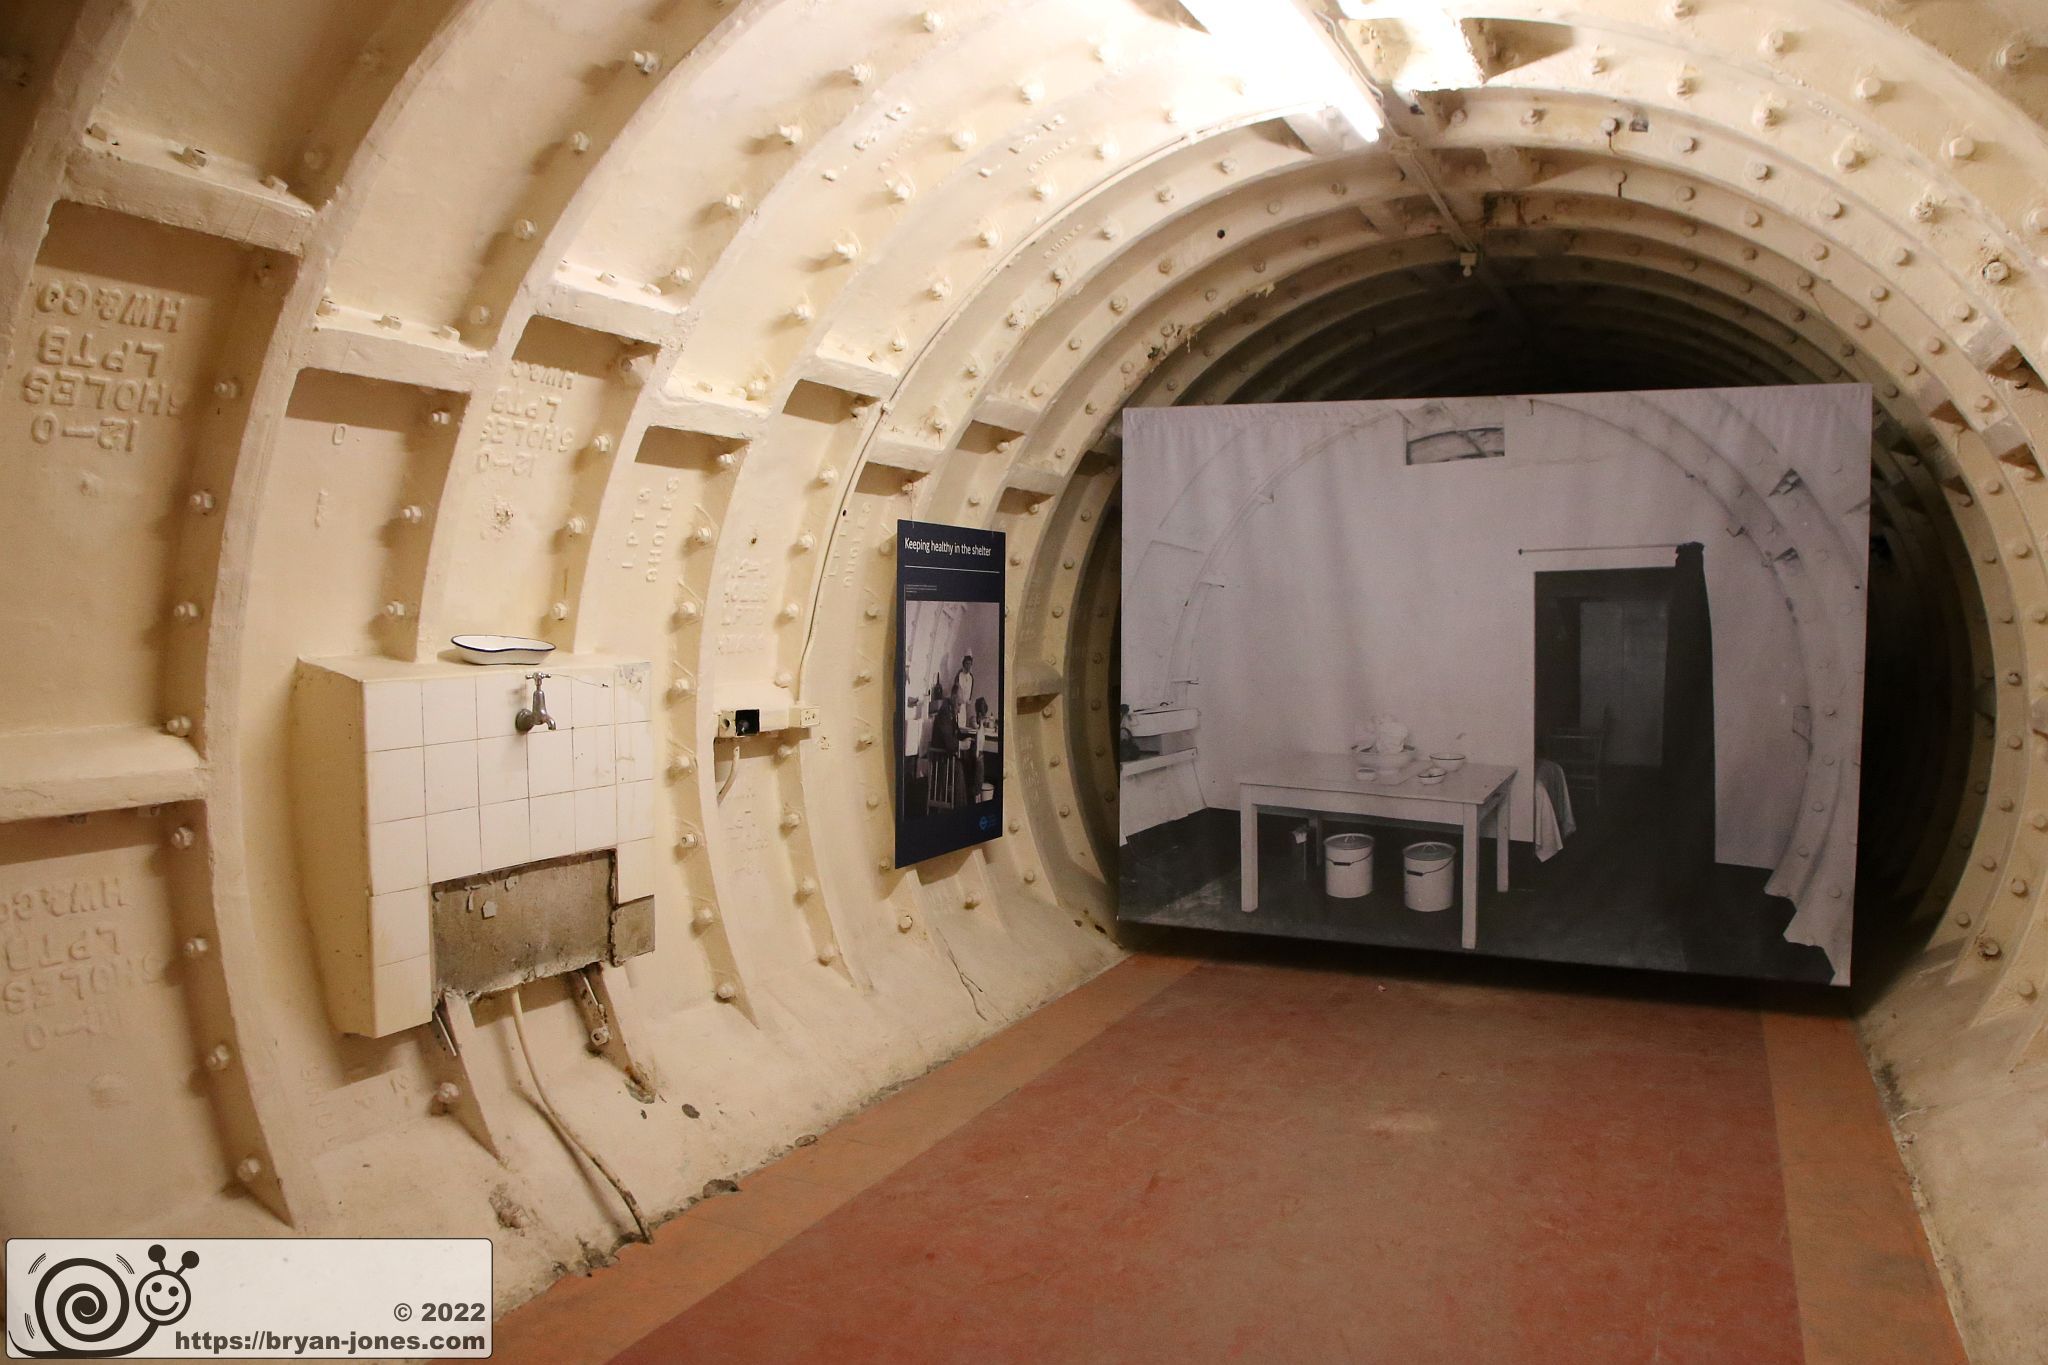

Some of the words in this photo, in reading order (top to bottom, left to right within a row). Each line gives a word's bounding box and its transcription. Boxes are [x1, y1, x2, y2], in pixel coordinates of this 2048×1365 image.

[905, 537, 930, 554] Keeping
[931, 540, 953, 556] healthy
[954, 542, 961, 554] in
[961, 543, 971, 555] the
[972, 544, 991, 557] shelter
